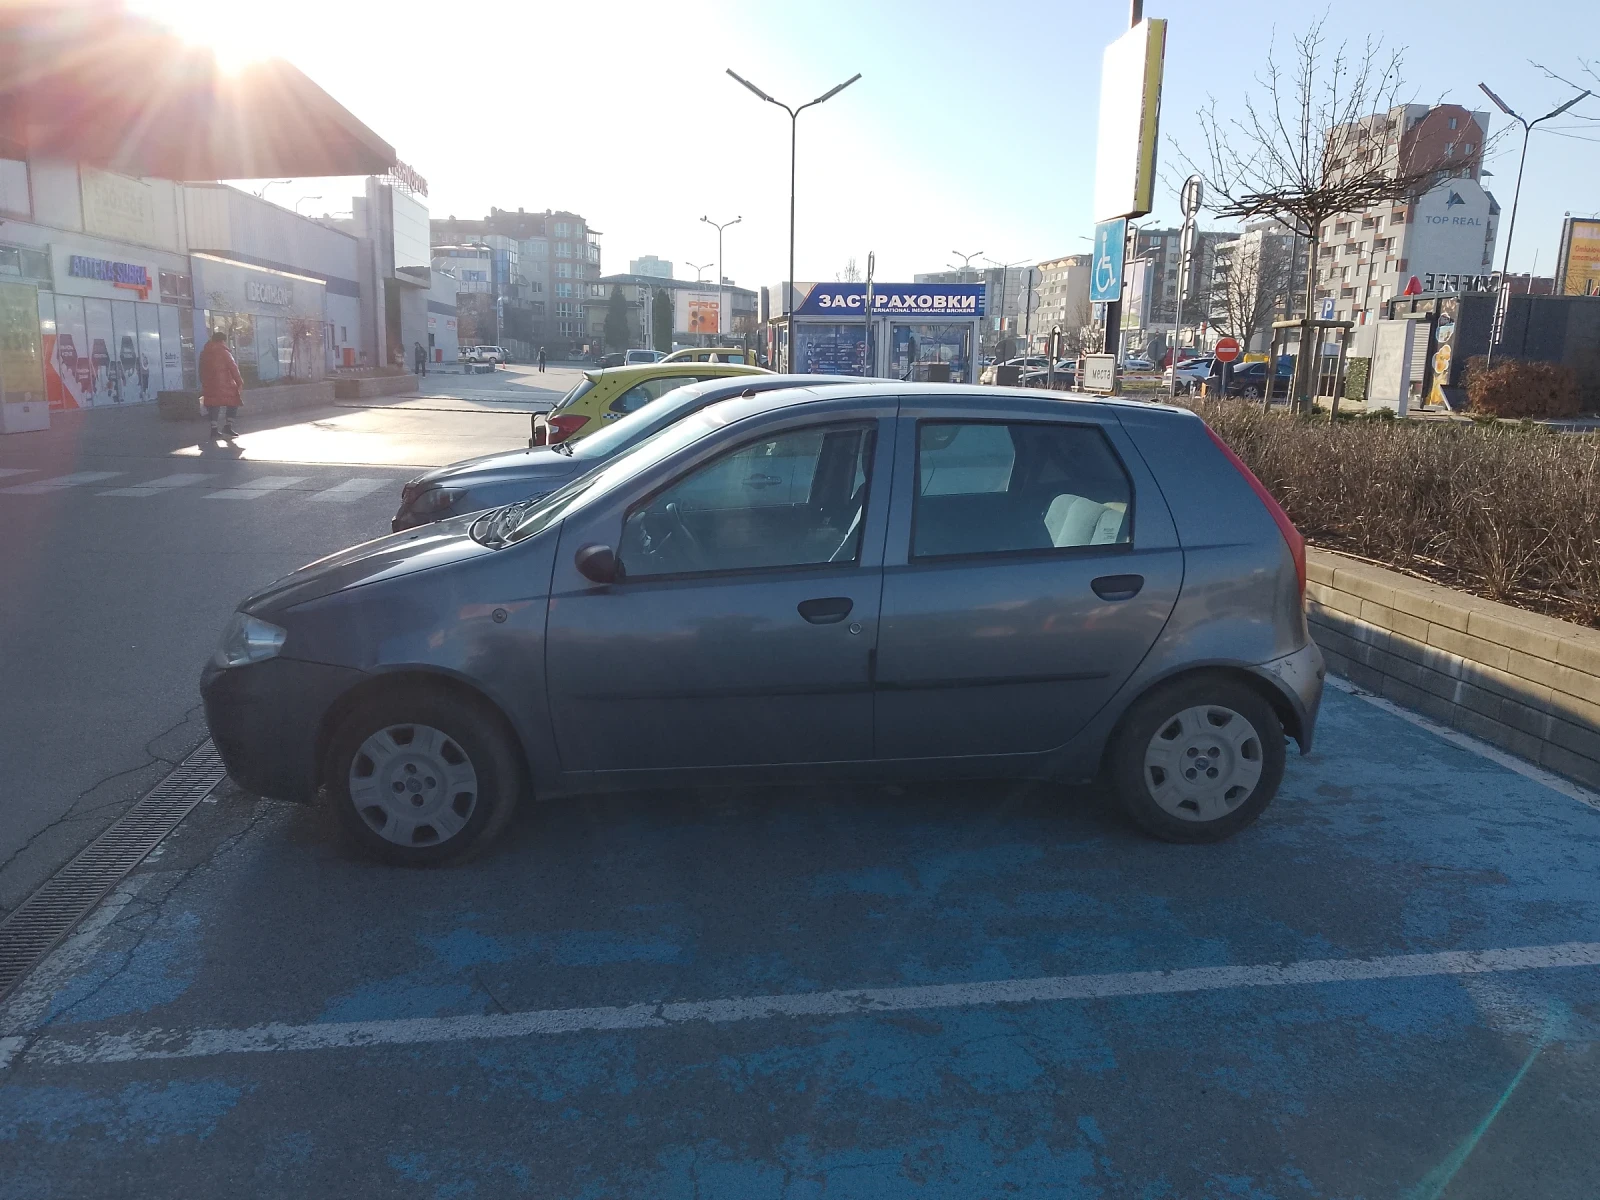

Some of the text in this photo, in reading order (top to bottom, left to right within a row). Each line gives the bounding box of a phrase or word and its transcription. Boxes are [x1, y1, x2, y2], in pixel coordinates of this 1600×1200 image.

[1426, 215, 1481, 226] TOP REAL
[248, 280, 288, 305] DECATHLON
[688, 301, 719, 309] PRO
